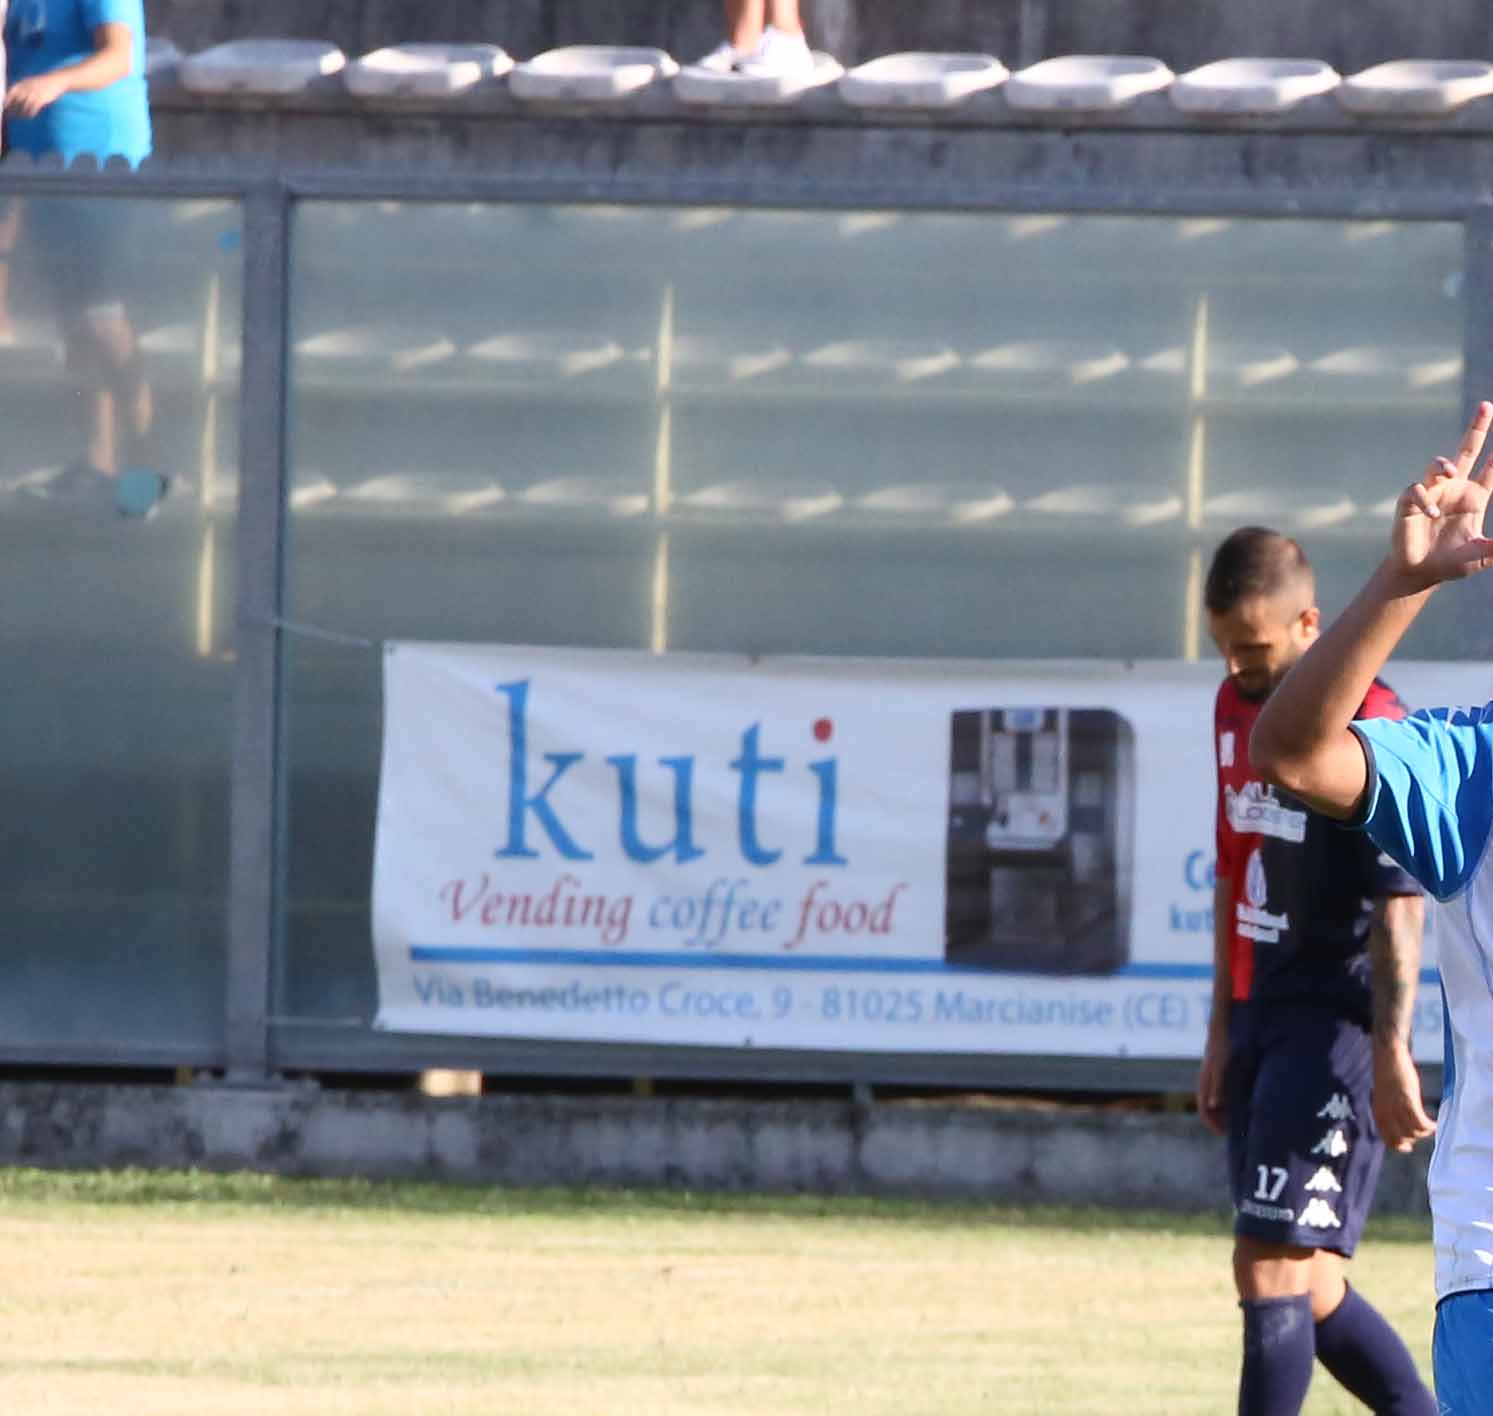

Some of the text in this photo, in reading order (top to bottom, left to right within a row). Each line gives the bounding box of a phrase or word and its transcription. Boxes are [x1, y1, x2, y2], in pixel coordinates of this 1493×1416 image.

[493, 678, 848, 867] kuti
[440, 873, 909, 950] Vending coffee food
[412, 974, 464, 1007] Via
[472, 977, 650, 1014] Benedetto
[772, 985, 792, 1018] 9
[821, 986, 923, 1024] 81025
[934, 988, 1114, 1027] Marcianise
[1254, 1164, 1289, 1201] 17
